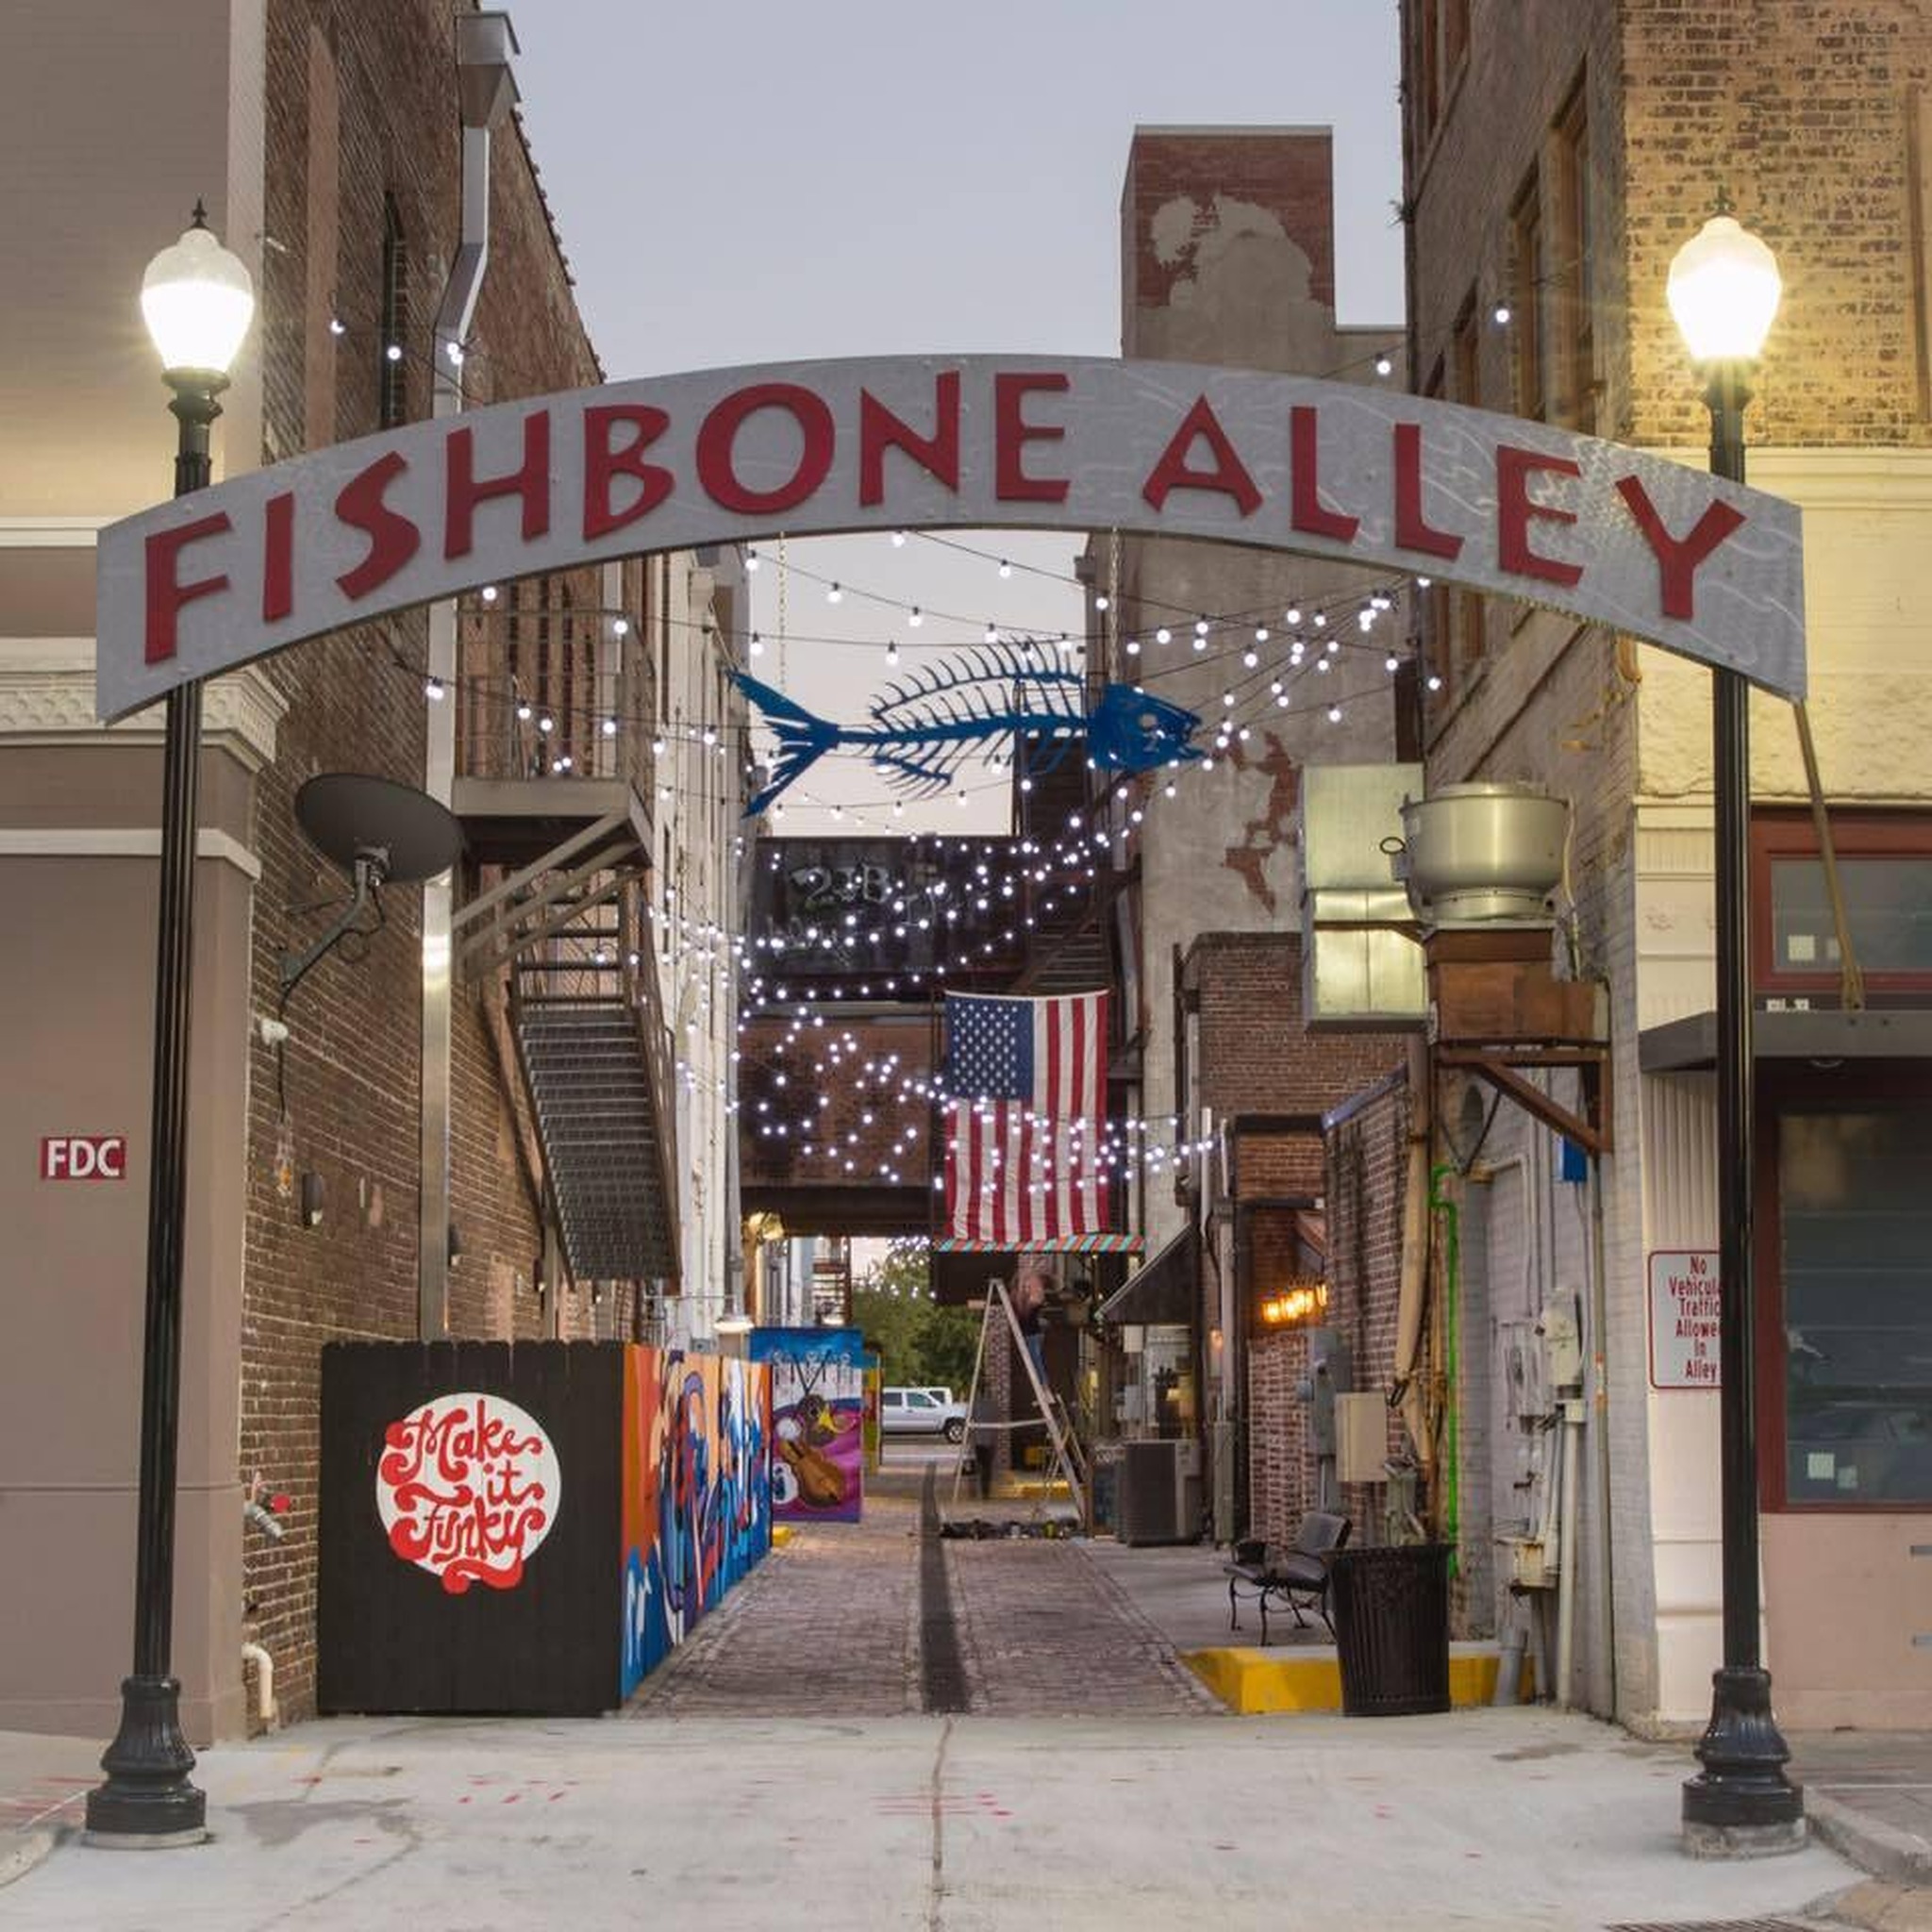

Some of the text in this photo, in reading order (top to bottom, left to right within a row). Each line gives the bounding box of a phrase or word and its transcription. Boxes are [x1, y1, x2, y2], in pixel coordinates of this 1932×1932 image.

[144, 372, 1745, 664] FISHBONE ALLEY
[47, 1139, 121, 1176] FDC
[1690, 1256, 1707, 1274] No
[1669, 1275, 1722, 1296] Vehicul
[1675, 1319, 1720, 1337] Allowe
[1694, 1339, 1706, 1357] In
[1686, 1359, 1716, 1383] Alley
[381, 1399, 543, 1485] Make
[483, 1460, 545, 1506] it
[389, 1482, 546, 1593] Funky
